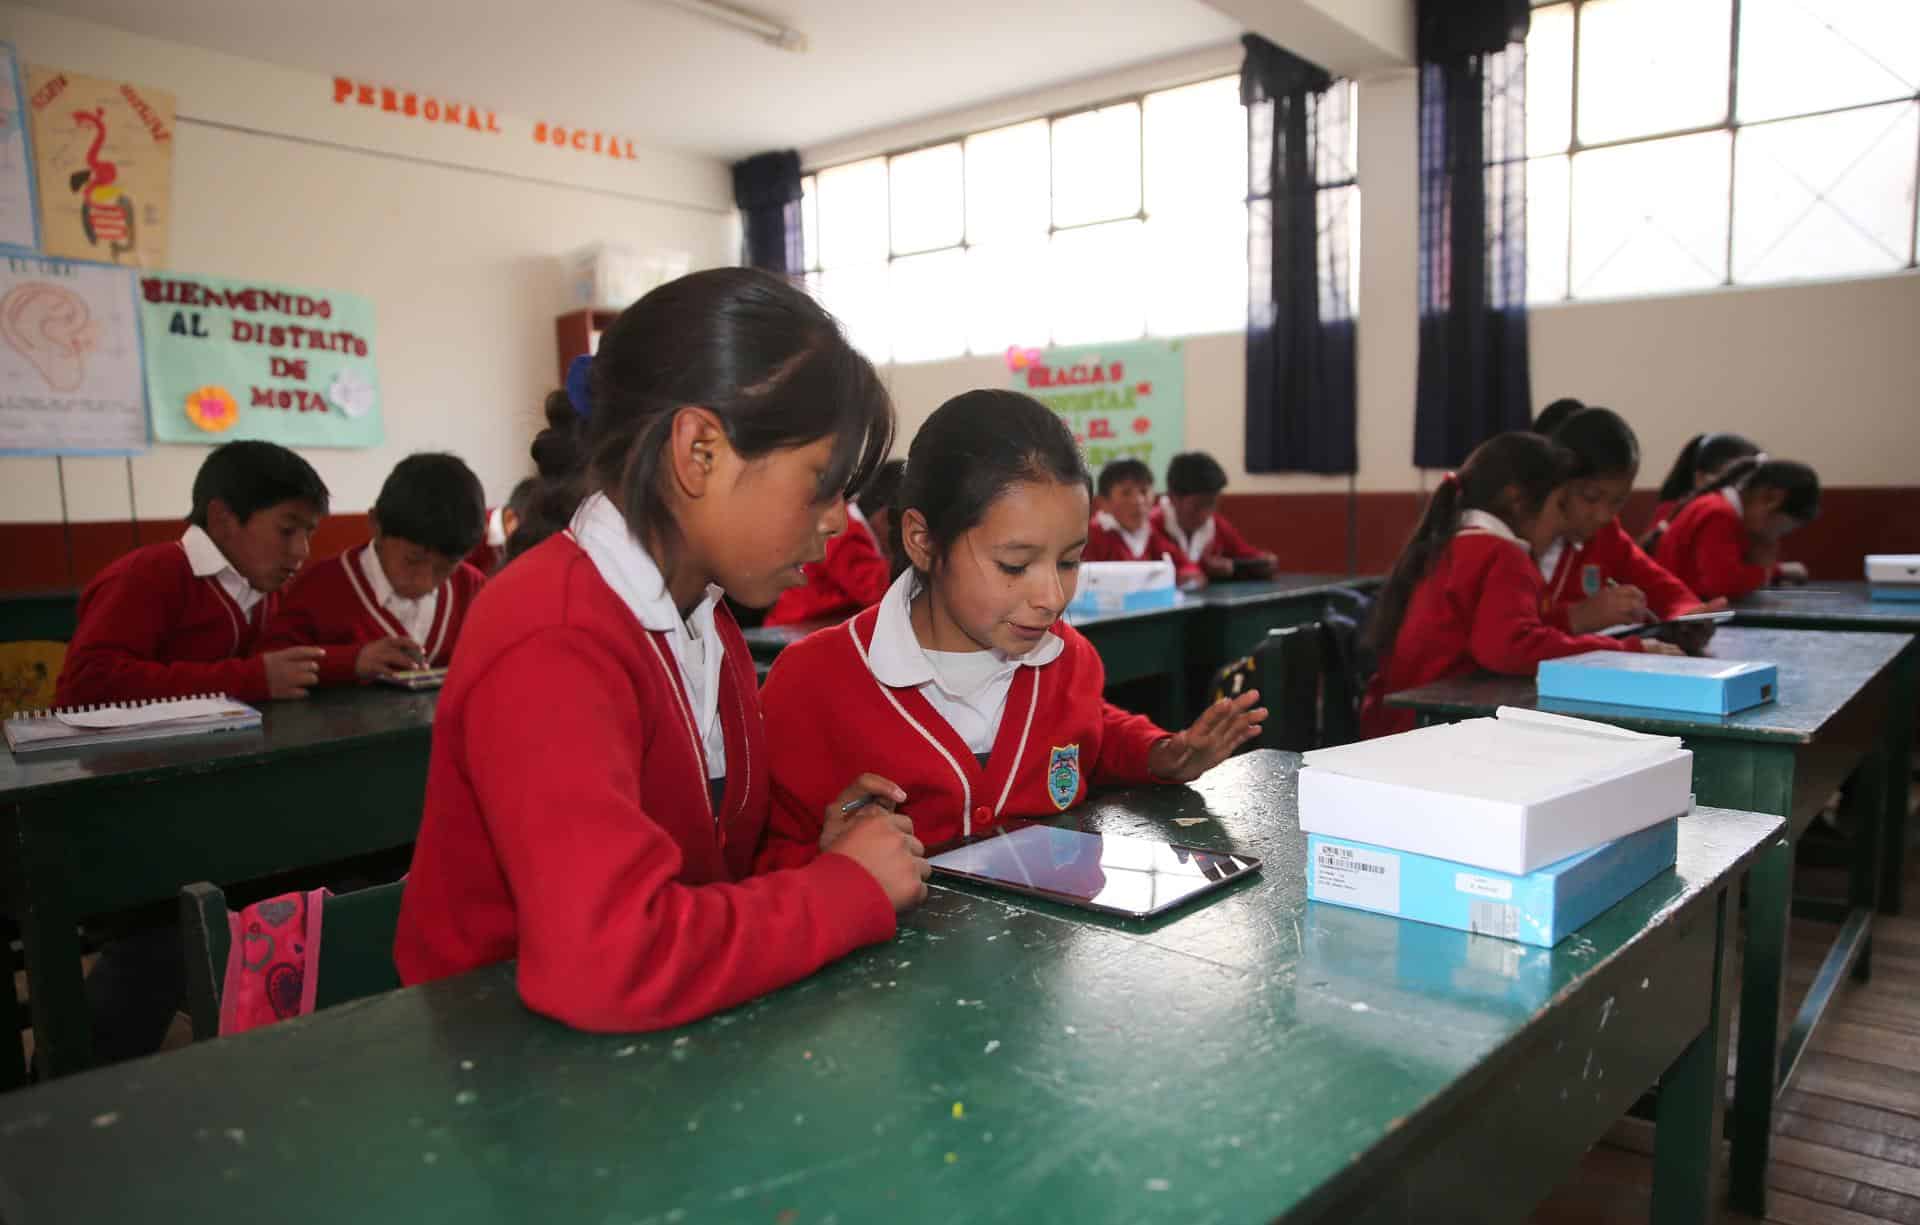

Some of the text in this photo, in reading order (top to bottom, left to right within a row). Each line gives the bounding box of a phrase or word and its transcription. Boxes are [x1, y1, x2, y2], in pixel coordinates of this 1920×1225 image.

[334, 77, 636, 159] PERSONAL SOCIAL
[142, 278, 332, 319] BIENVENIDO
[169, 311, 368, 357] AL DISTRITO
[270, 357, 308, 380] DE
[1027, 361, 1124, 389] GRACIAS
